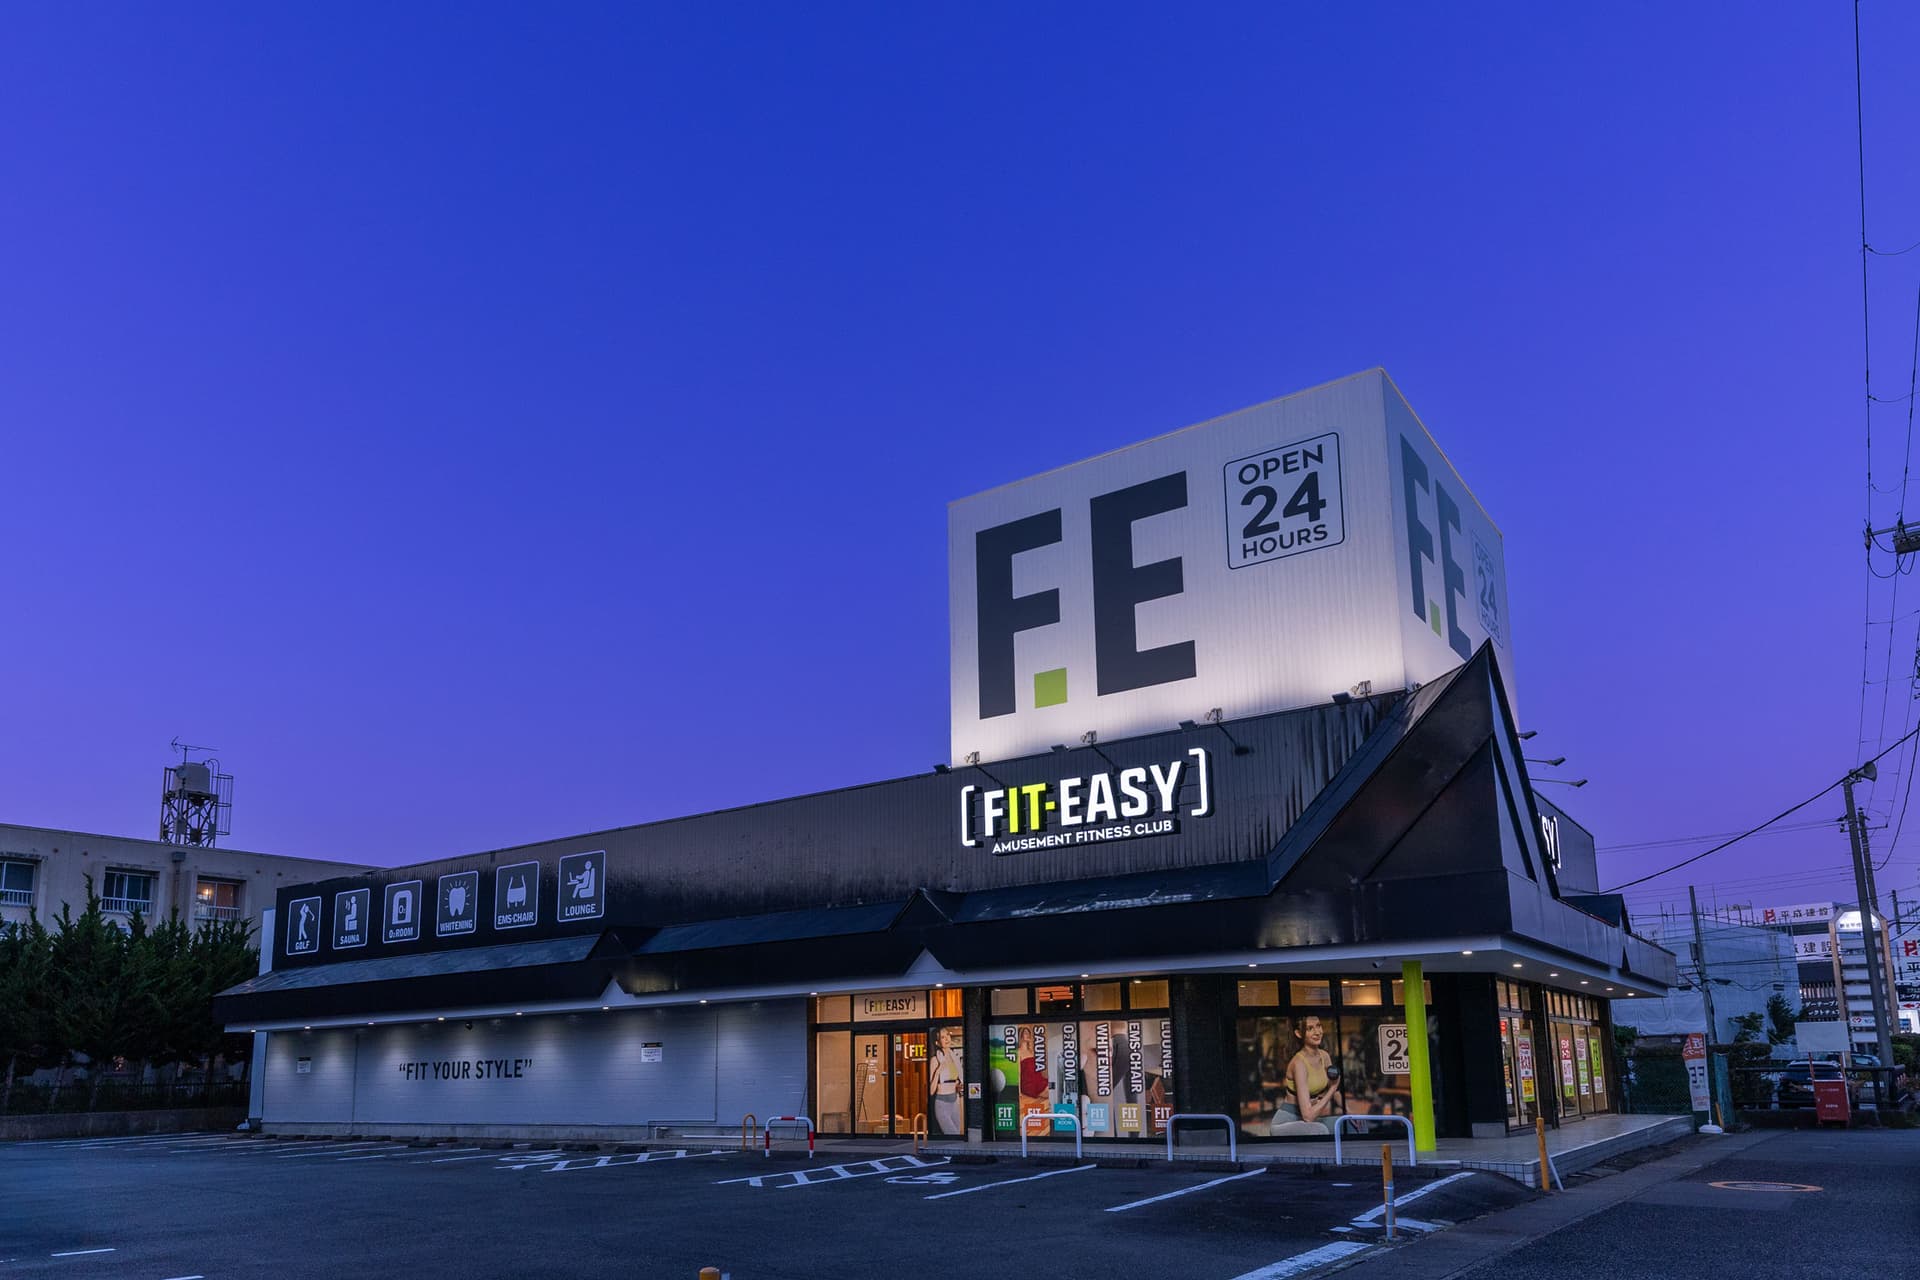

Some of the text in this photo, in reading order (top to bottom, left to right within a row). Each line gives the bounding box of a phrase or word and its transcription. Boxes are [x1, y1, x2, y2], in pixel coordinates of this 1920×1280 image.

[1238, 443, 1323, 485] OPEN
[1240, 471, 1327, 539] 24
[1242, 523, 1328, 559] HOURS
[1478, 564, 1498, 622] 24
[992, 819, 1173, 853] AMUSEMENT FITNESS CLUB
[565, 903, 597, 917] LOUNGE
[439, 919, 473, 932] WHITENING
[295, 941, 311, 951] GOLF
[340, 934, 360, 945] SAUNA
[1004, 1026, 1016, 1062] GOLF
[1386, 1029, 1408, 1039] OPE
[1034, 1025, 1046, 1072] SAUNA
[1160, 1020, 1173, 1078] LOUNGE
[1387, 1039, 1409, 1061] 2
[1096, 1023, 1111, 1096] WHITENING
[432, 1061, 471, 1080] YOUR
[998, 1107, 1012, 1118] FIT
[1091, 1108, 1104, 1119] FIT
[1121, 1107, 1138, 1119] FIT
[1154, 1107, 1171, 1119] FIT
